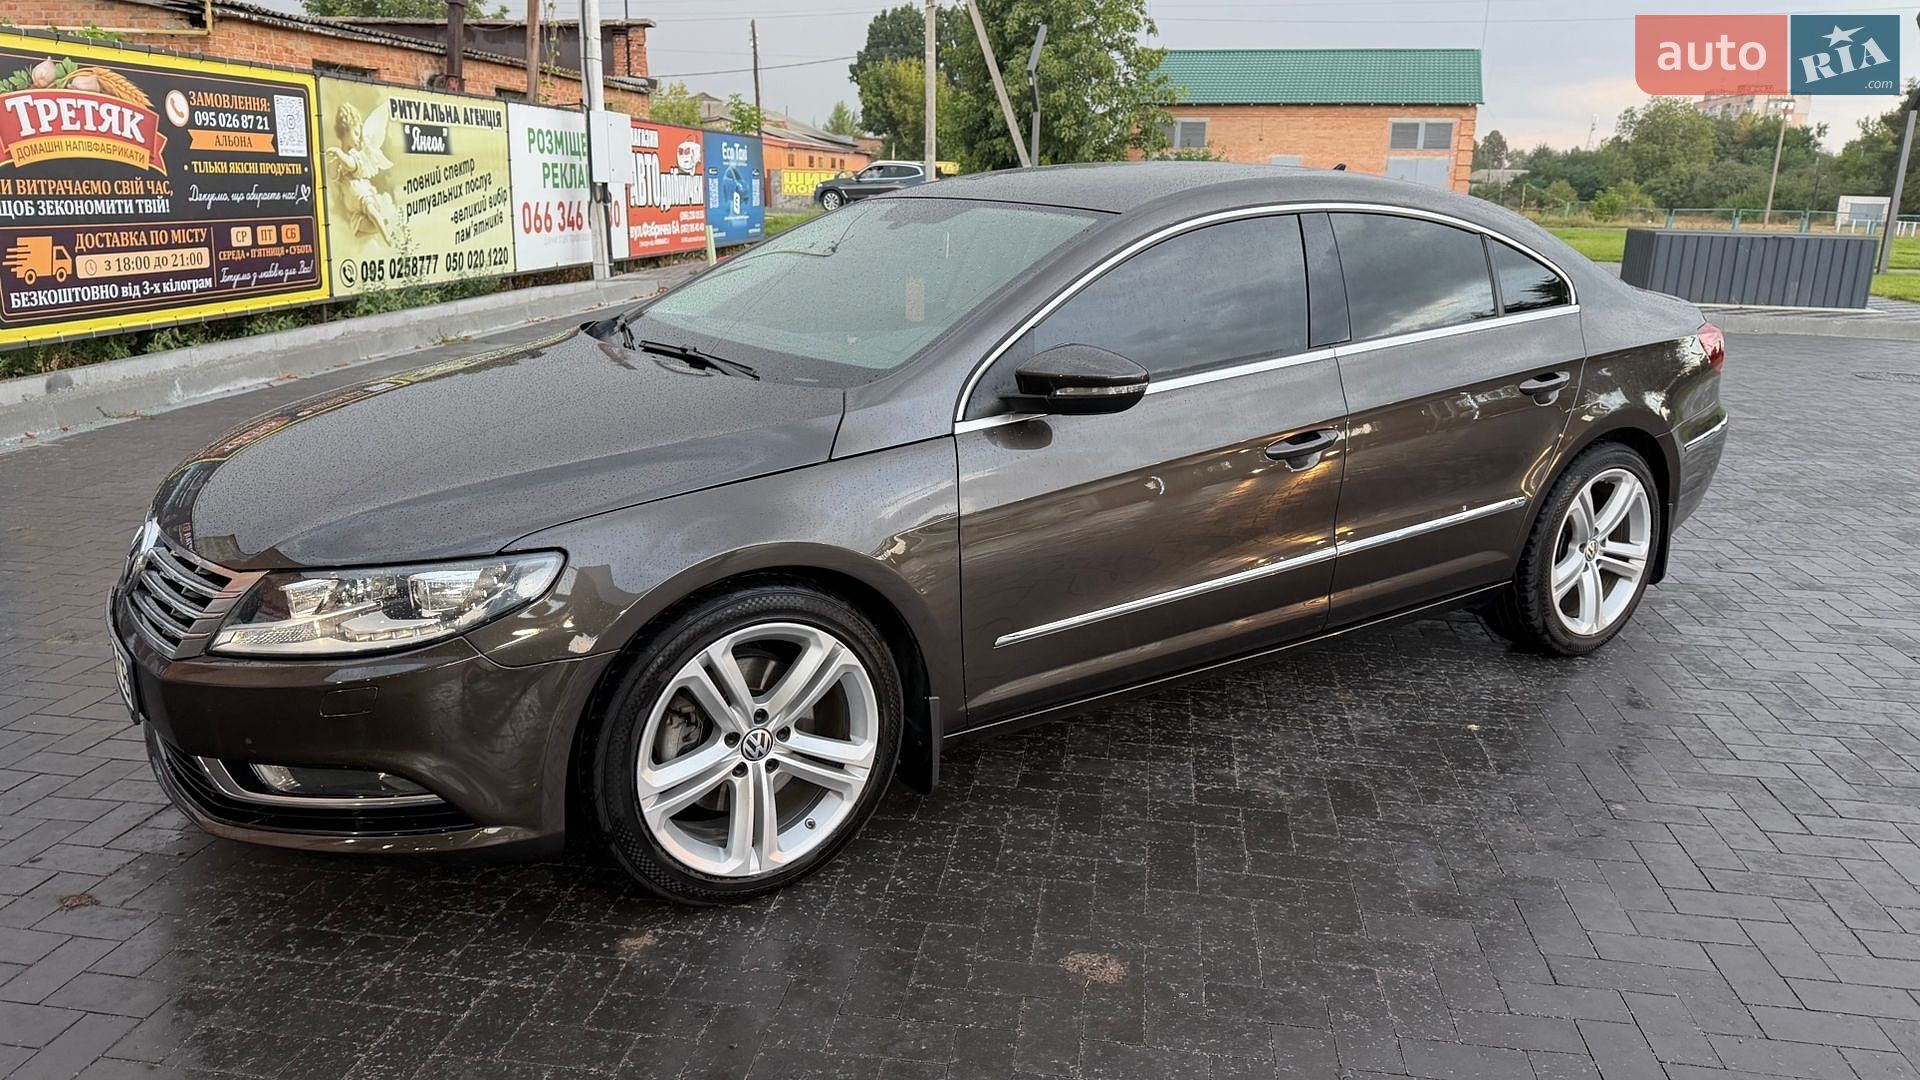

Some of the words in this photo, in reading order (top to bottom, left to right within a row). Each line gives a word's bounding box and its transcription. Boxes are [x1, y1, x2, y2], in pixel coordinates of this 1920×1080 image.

[188, 90, 271, 113] ЗАМОВЛЕННЯ:
[6, 94, 146, 144] ТРЕТЯК
[194, 110, 217, 127] 095
[218, 112, 240, 129] 026
[240, 113, 254, 129] 87
[255, 115, 270, 130] 21
[390, 98, 461, 125] РИТУАЛЬНА
[463, 106, 502, 130] АГЕНЦІЯ
[16, 140, 64, 161] ДОМАШНІ
[63, 141, 146, 164] НАПІВФАБРИКАТИ
[214, 133, 253, 148] АЛЬОНА
[527, 127, 587, 161] РОЗМІЩЕ
[192, 161, 228, 174] ТІЛЬКИ
[228, 162, 259, 174] ЯКІСНІ
[260, 162, 302, 175] ПРОДУКТИ
[443, 158, 475, 181] спектр
[0, 179, 13, 195] И
[17, 180, 111, 196] ВИТРАЧАЄМО
[114, 177, 145, 195] СВІЙ
[146, 179, 174, 198] ЧАС,
[406, 188, 463, 222] ритуальних
[465, 172, 492, 195] послуг
[489, 187, 508, 207] вибір
[38, 199, 134, 216] ЗЕКОНОМИТИ
[135, 196, 171, 214] ТВІЙ!
[522, 201, 552, 234] 066
[557, 201, 583, 231] 346
[236, 231, 247, 242] СР
[260, 229, 273, 241] ПТ
[285, 228, 296, 239] СБ
[455, 211, 503, 244] пам'ятників
[75, 229, 148, 252] ДОСТАВКА
[150, 230, 168, 246] ПО
[171, 227, 207, 245] МІСТУ
[116, 255, 151, 271] 18:00
[153, 257, 168, 270] до
[171, 252, 203, 267] 21:00
[219, 249, 246, 261] СЕРЕДА
[289, 244, 313, 255] СУБОТА
[361, 259, 385, 282] 095
[390, 255, 438, 279] 0258777
[445, 252, 463, 272] 050
[467, 250, 484, 270] 020
[488, 247, 508, 267] 1220
[10, 283, 118, 308] БЕЗКОШТОВНО
[121, 282, 141, 299] від
[143, 280, 161, 296] 3-х
[163, 276, 213, 296] кілограм
